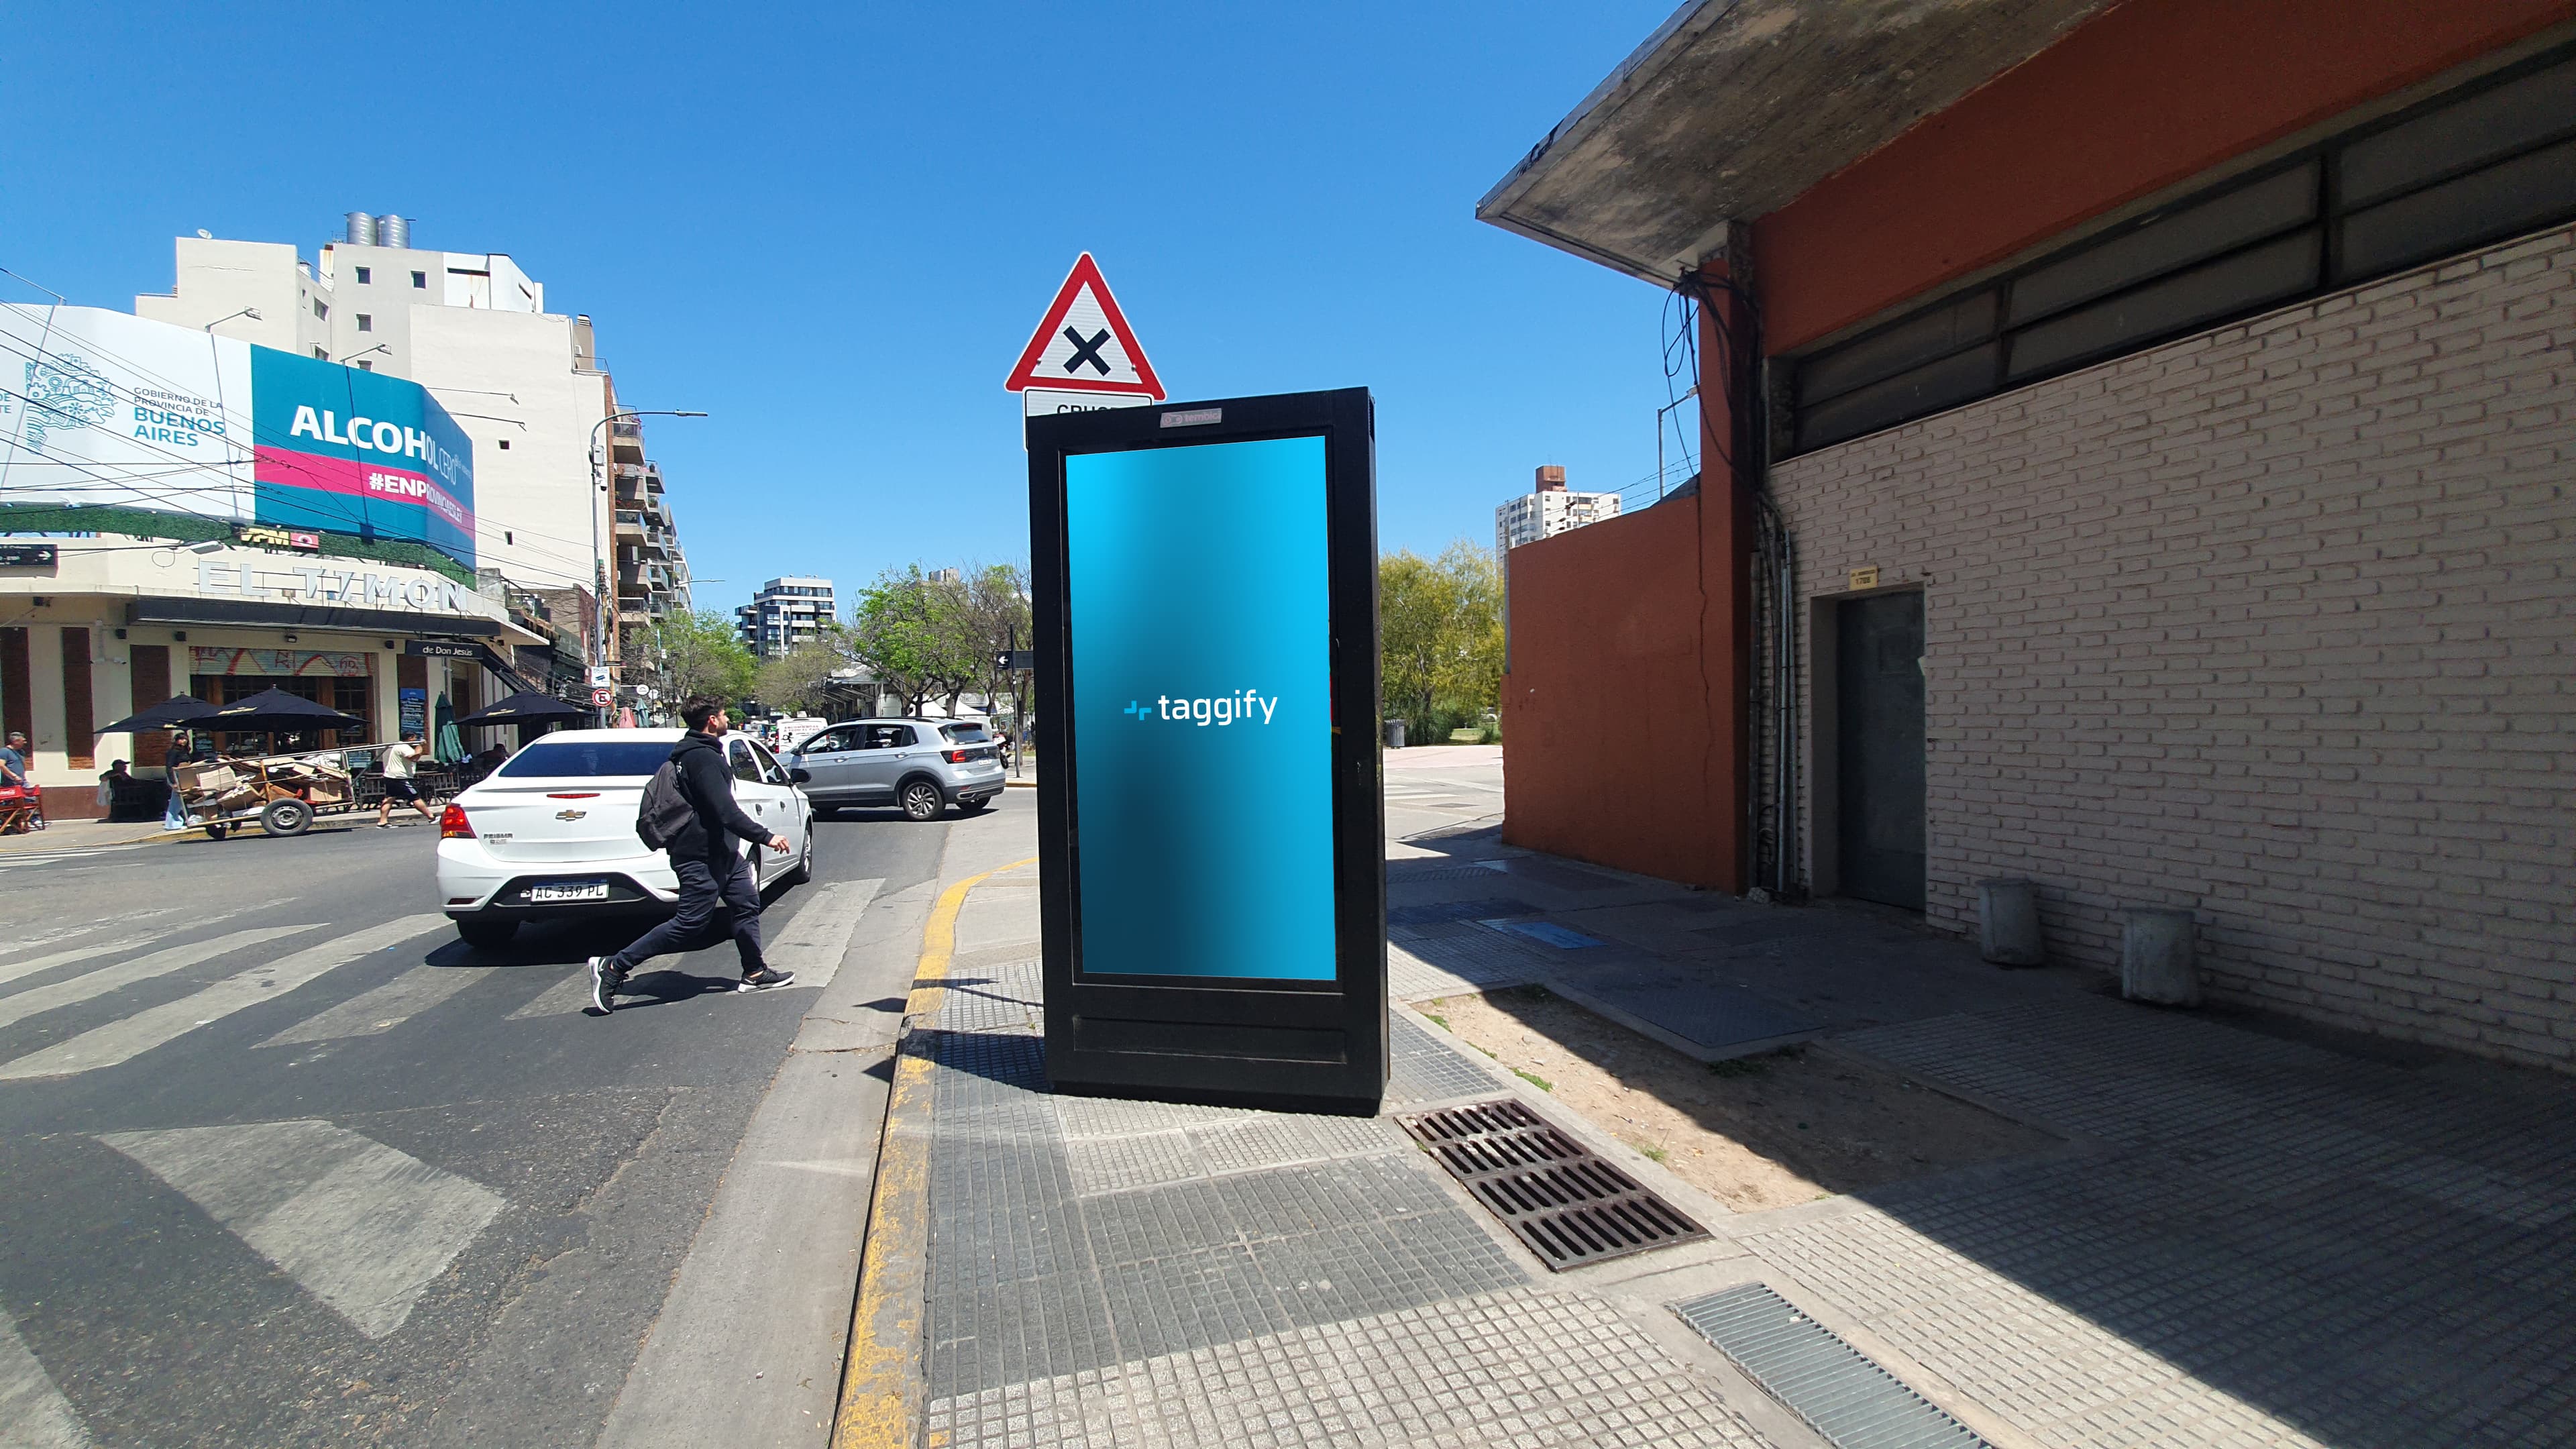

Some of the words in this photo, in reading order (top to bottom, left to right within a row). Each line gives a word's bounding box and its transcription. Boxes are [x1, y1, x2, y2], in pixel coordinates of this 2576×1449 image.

[134, 387, 191, 403] GOBIERNO
[193, 398, 207, 407] DE
[210, 400, 222, 409] LA
[134, 396, 193, 413] PROVINCIA
[195, 407, 209, 416] DE
[134, 407, 225, 435] BUENOS
[134, 425, 199, 447] AIRES
[290, 405, 439, 471] ALCOHOL
[199, 558, 271, 597] EL
[435, 646, 451, 655] Don
[453, 647, 473, 656] Jesús
[1158, 689, 1278, 727] taggify
[535, 887, 552, 899] AC
[557, 885, 583, 898] 339
[588, 885, 603, 897] PL
